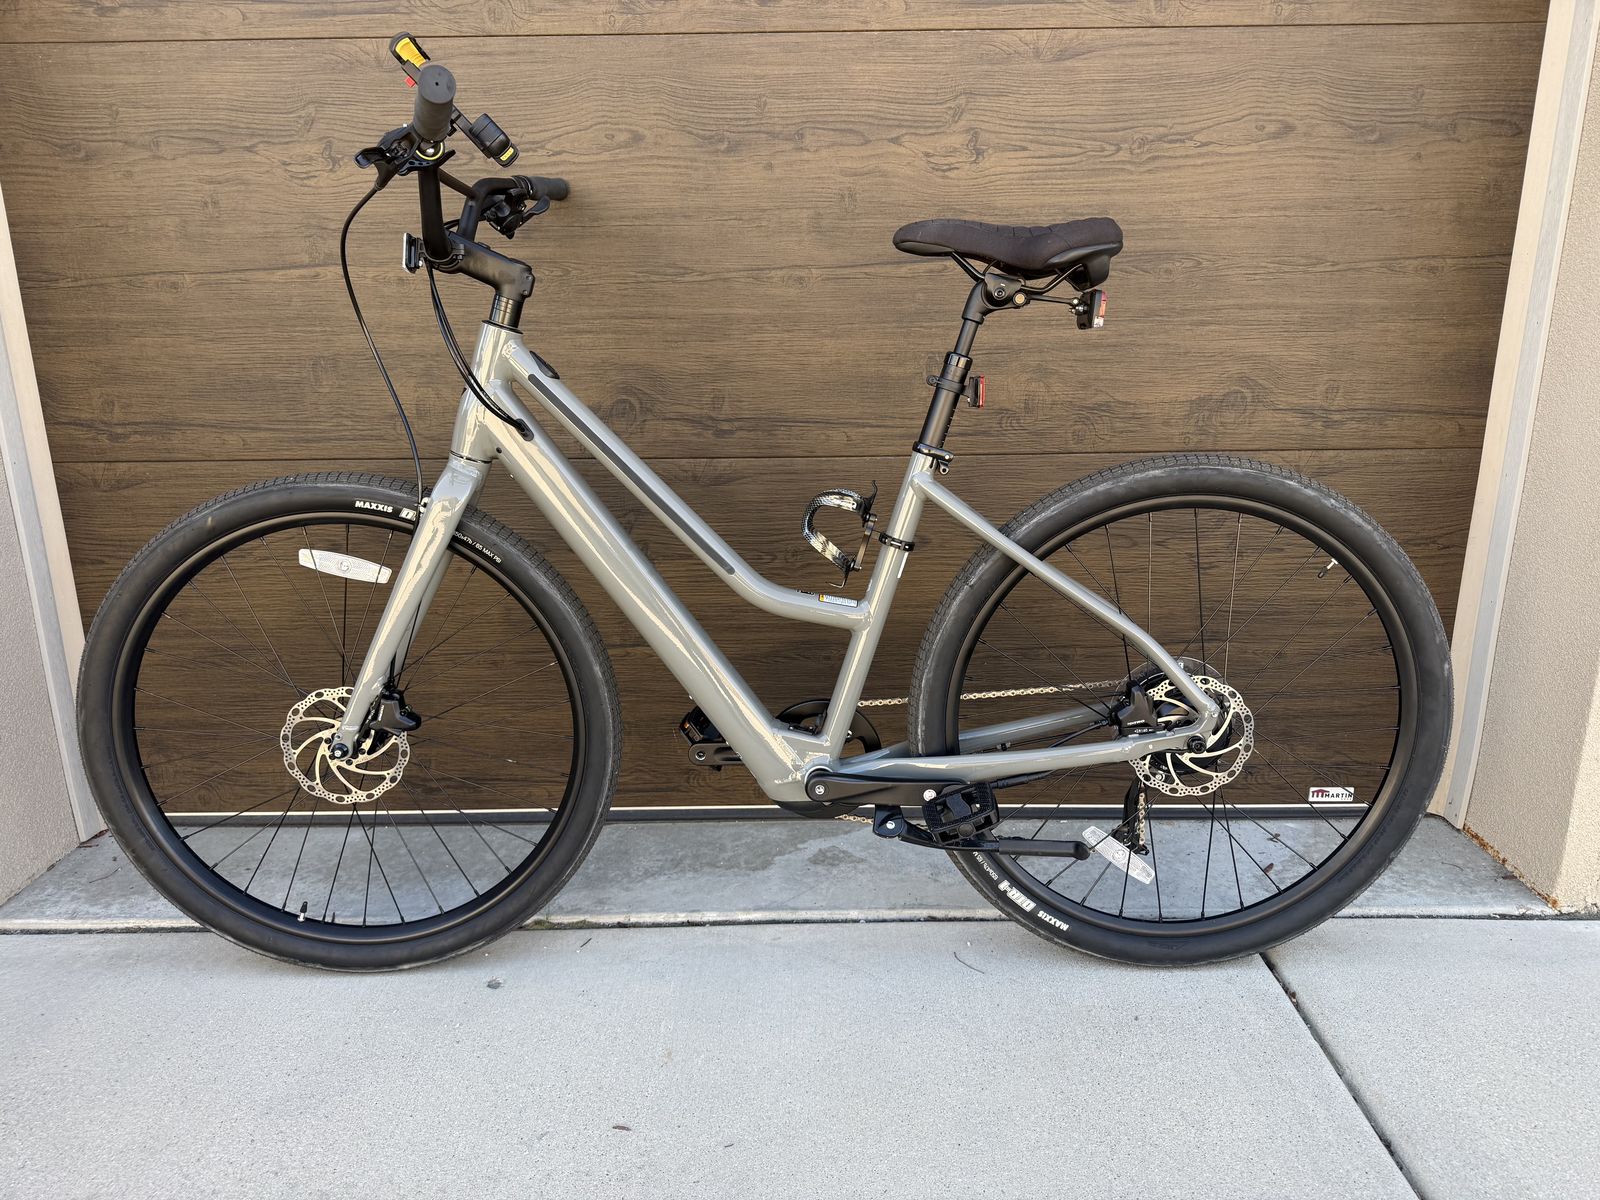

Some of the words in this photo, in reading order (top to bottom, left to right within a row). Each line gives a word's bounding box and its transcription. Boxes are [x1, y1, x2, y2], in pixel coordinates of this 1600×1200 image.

[355, 501, 393, 513] MAXXIS
[455, 531, 473, 545] 50x47b
[482, 547, 494, 558] MAX
[998, 880, 1037, 912] DTR-1
[1038, 911, 1069, 931] MAXXIS
